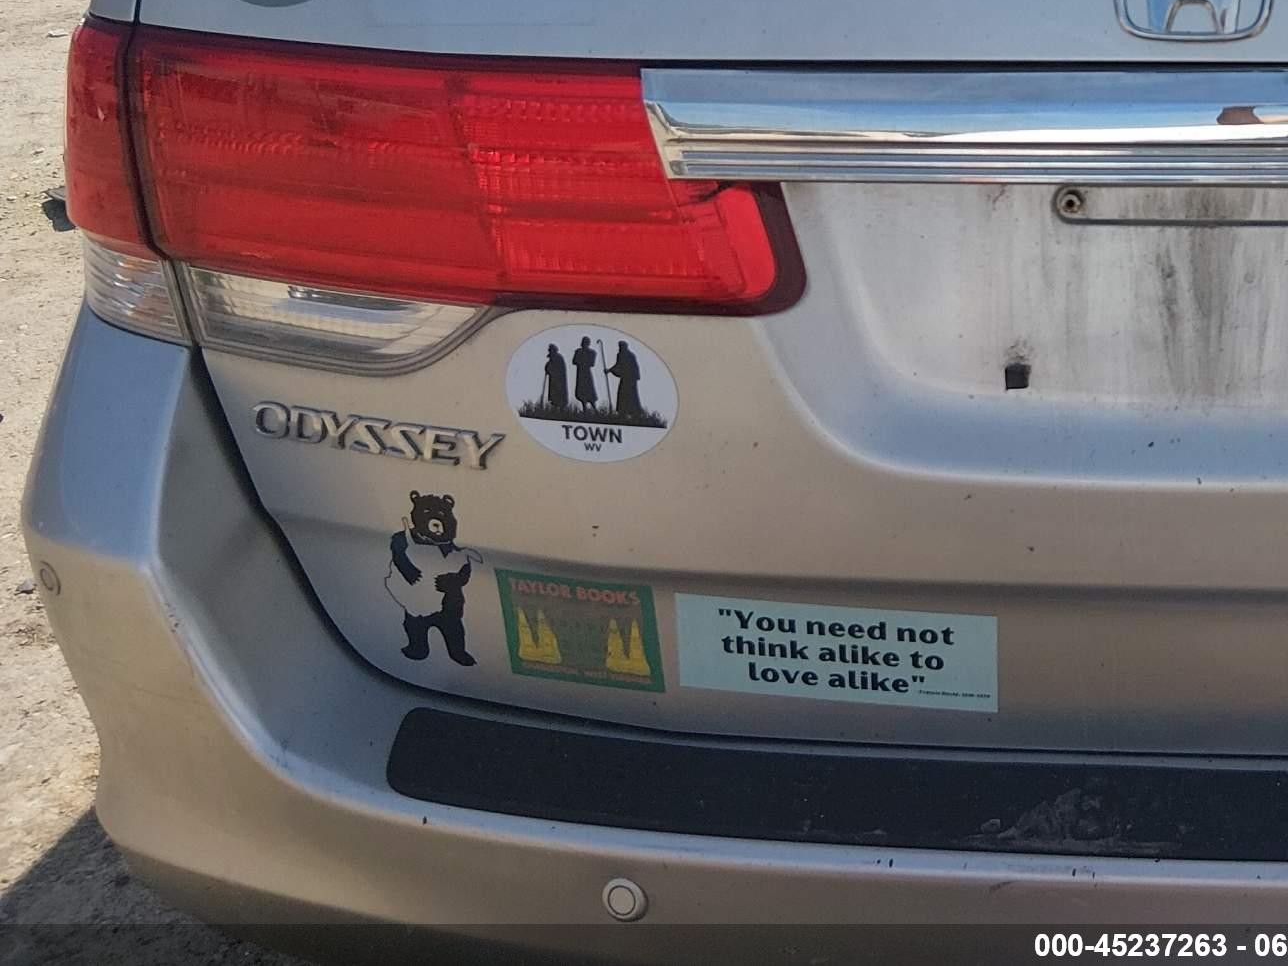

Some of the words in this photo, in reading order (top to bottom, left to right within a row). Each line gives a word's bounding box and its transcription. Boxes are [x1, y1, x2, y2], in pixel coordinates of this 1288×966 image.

[252, 401, 506, 471] ODYSSEY
[561, 424, 623, 444] TOWN
[584, 442, 603, 452] WV
[508, 579, 572, 599] TAYLOR
[575, 586, 641, 606] BOOKS
[718, 608, 796, 634] "You
[806, 620, 887, 641] need
[896, 626, 955, 646] not
[721, 635, 809, 661] think
[818, 643, 900, 668] alike
[910, 650, 945, 671] to
[748, 661, 819, 686] love
[828, 667, 926, 694] alike"
